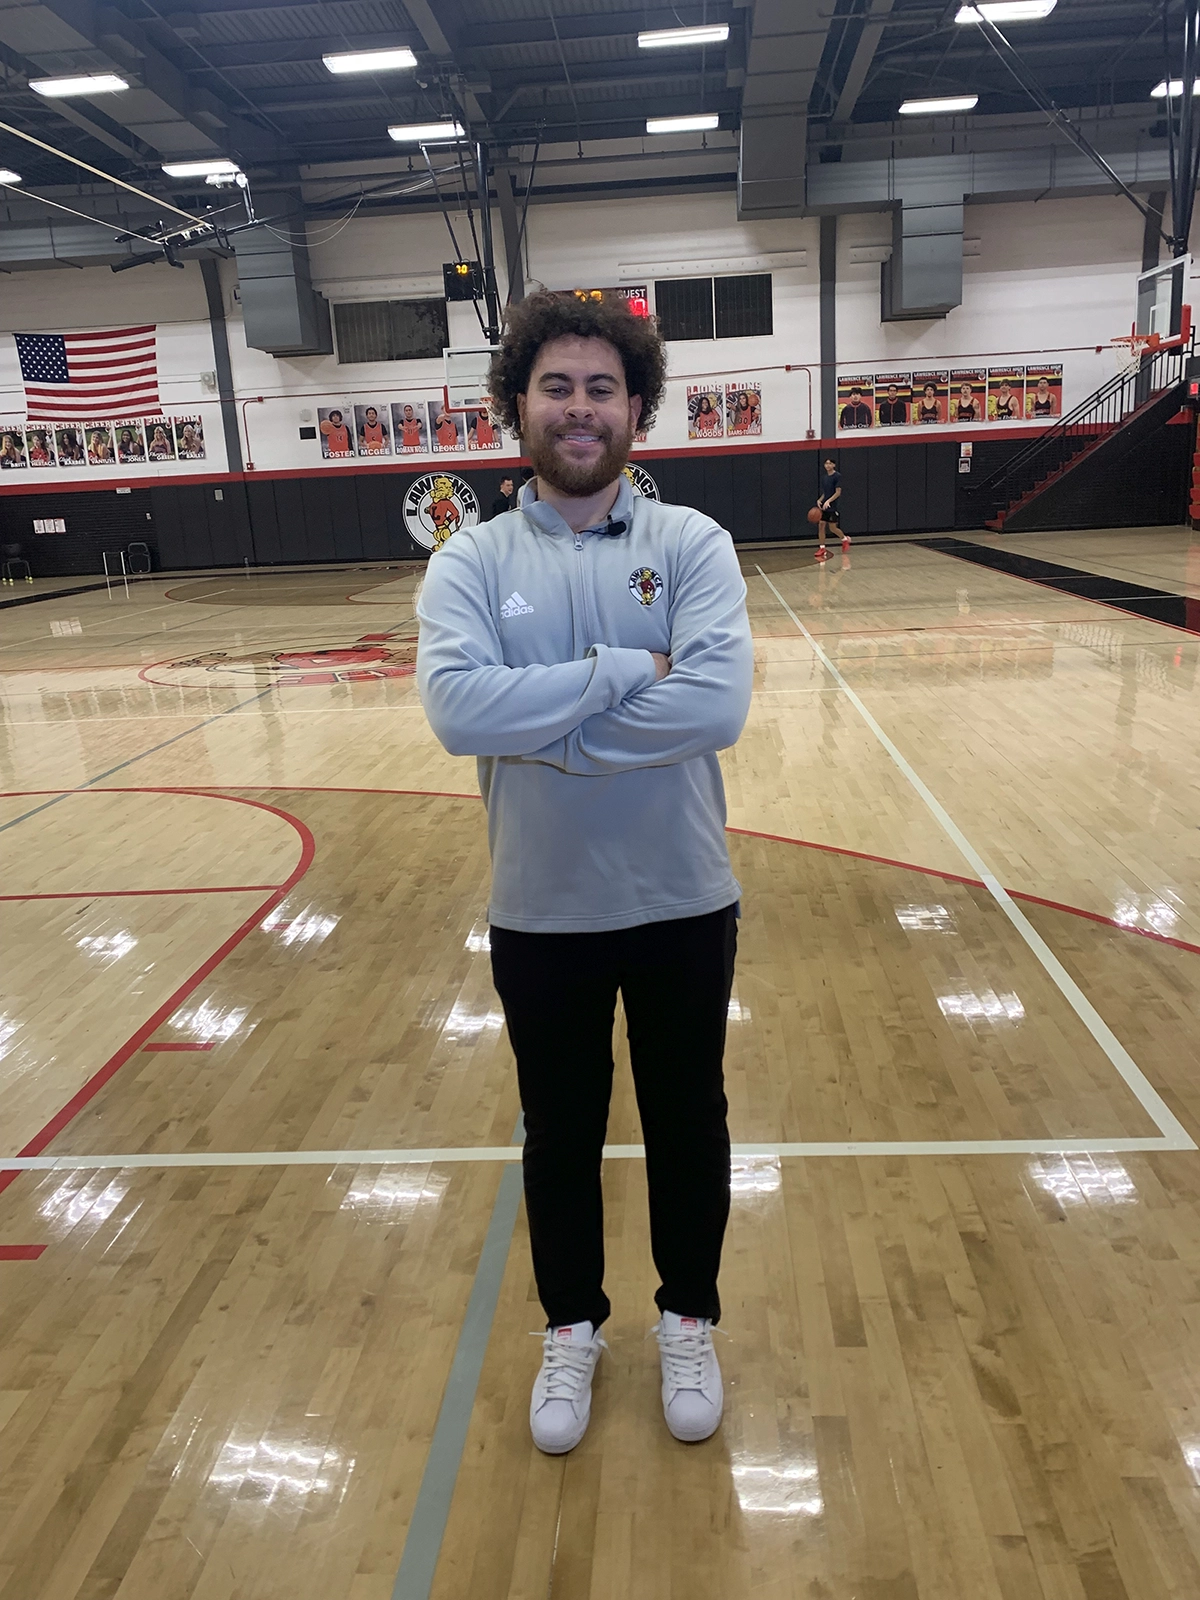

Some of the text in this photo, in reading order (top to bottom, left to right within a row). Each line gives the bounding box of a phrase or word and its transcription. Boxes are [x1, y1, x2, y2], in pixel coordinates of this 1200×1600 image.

[617, 289, 646, 299] GUEST
[691, 384, 723, 395] LIONS
[729, 382, 761, 393] LIONS
[114, 419, 142, 428] CHEER
[145, 416, 169, 426] POM
[176, 415, 198, 424] POM
[0, 424, 23, 433] HEER
[25, 423, 52, 432] CHEER
[55, 421, 82, 431] CHEER
[84, 420, 111, 430] CHEER
[470, 442, 501, 450] BLAND
[324, 450, 355, 458] FOSTER
[360, 447, 391, 456] MCGEE
[406, 475, 477, 516] LAWNCE
